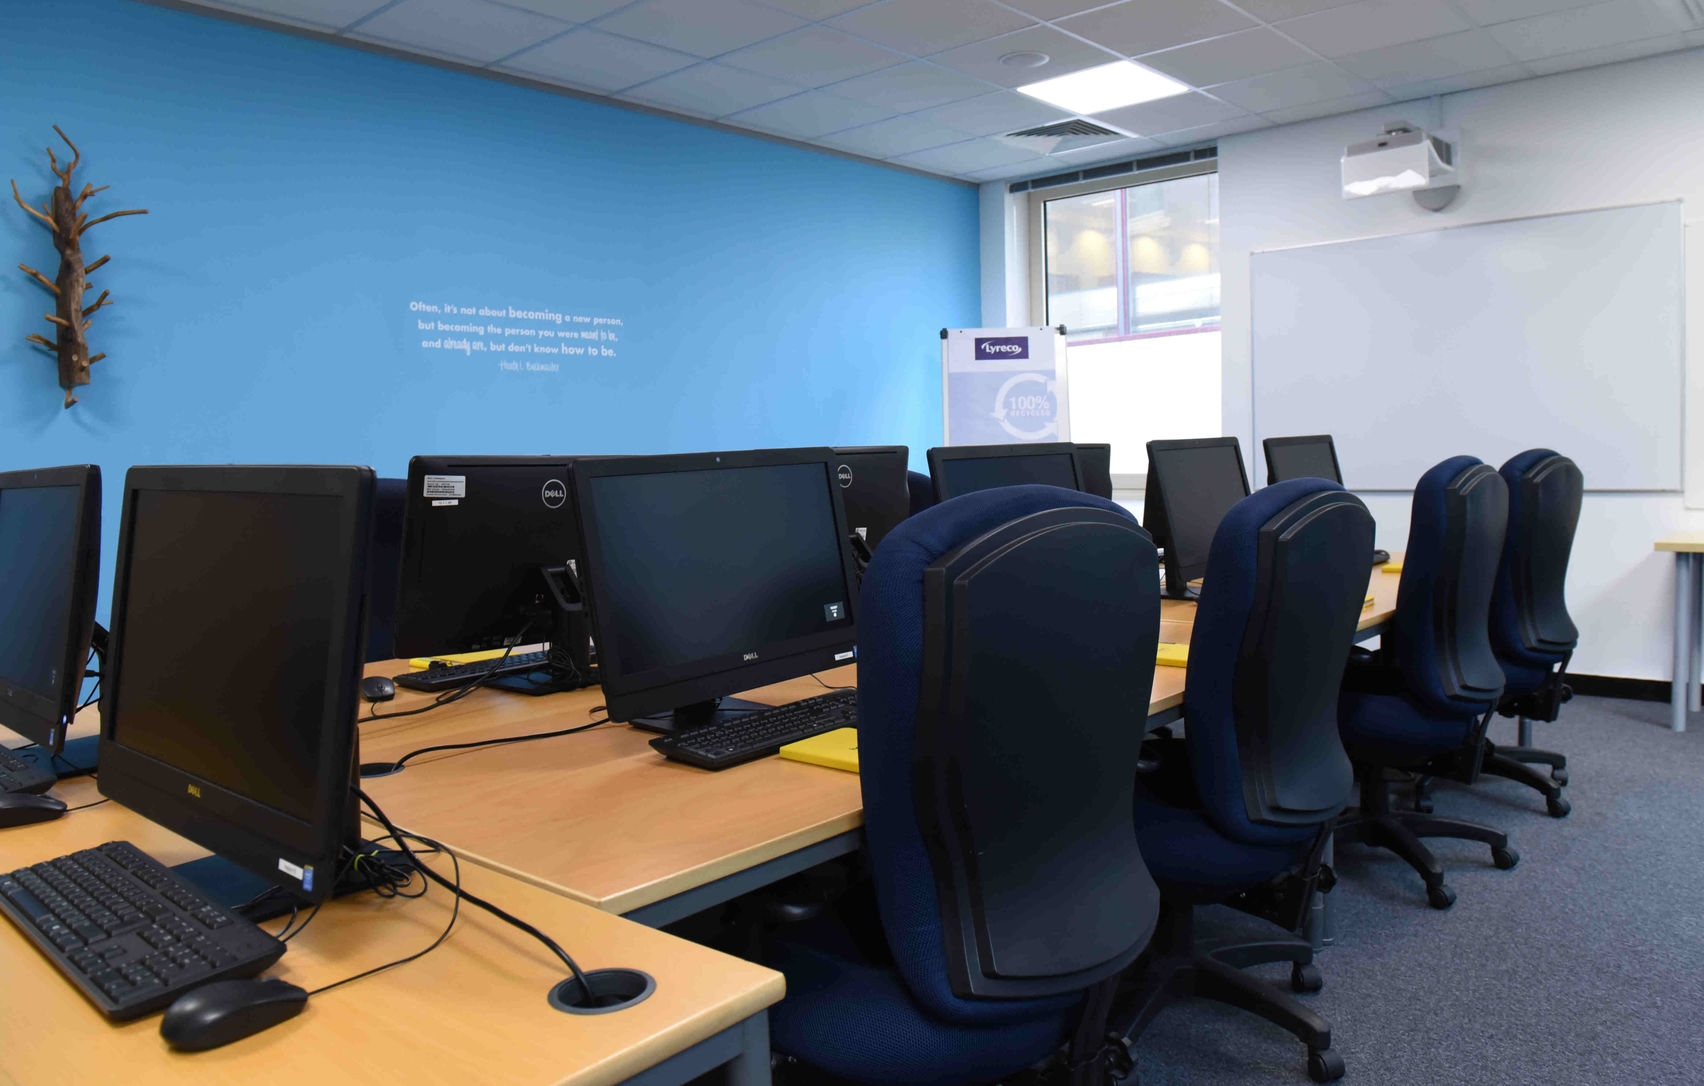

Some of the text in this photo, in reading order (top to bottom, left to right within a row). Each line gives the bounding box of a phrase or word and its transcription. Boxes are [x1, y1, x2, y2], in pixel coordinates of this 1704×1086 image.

[410, 301, 441, 314] Often,
[444, 304, 457, 314] it's
[460, 306, 476, 315] not
[479, 306, 506, 317] about
[509, 307, 562, 324] becoming
[573, 315, 590, 323] new
[594, 316, 623, 326] person,
[418, 320, 434, 330] but
[438, 321, 484, 335] becoming
[488, 324, 502, 334] the
[505, 327, 535, 336] person
[538, 329, 554, 338] you
[557, 330, 579, 338] were
[422, 339, 441, 348] and
[490, 341, 505, 351] but
[508, 343, 531, 353] don't
[534, 344, 558, 354] know
[561, 343, 584, 355] how
[588, 346, 598, 356] to
[985, 342, 1020, 354] Lyreco
[1010, 396, 1050, 410] 100%
[544, 490, 564, 498] DELL
[744, 652, 758, 661] DELL
